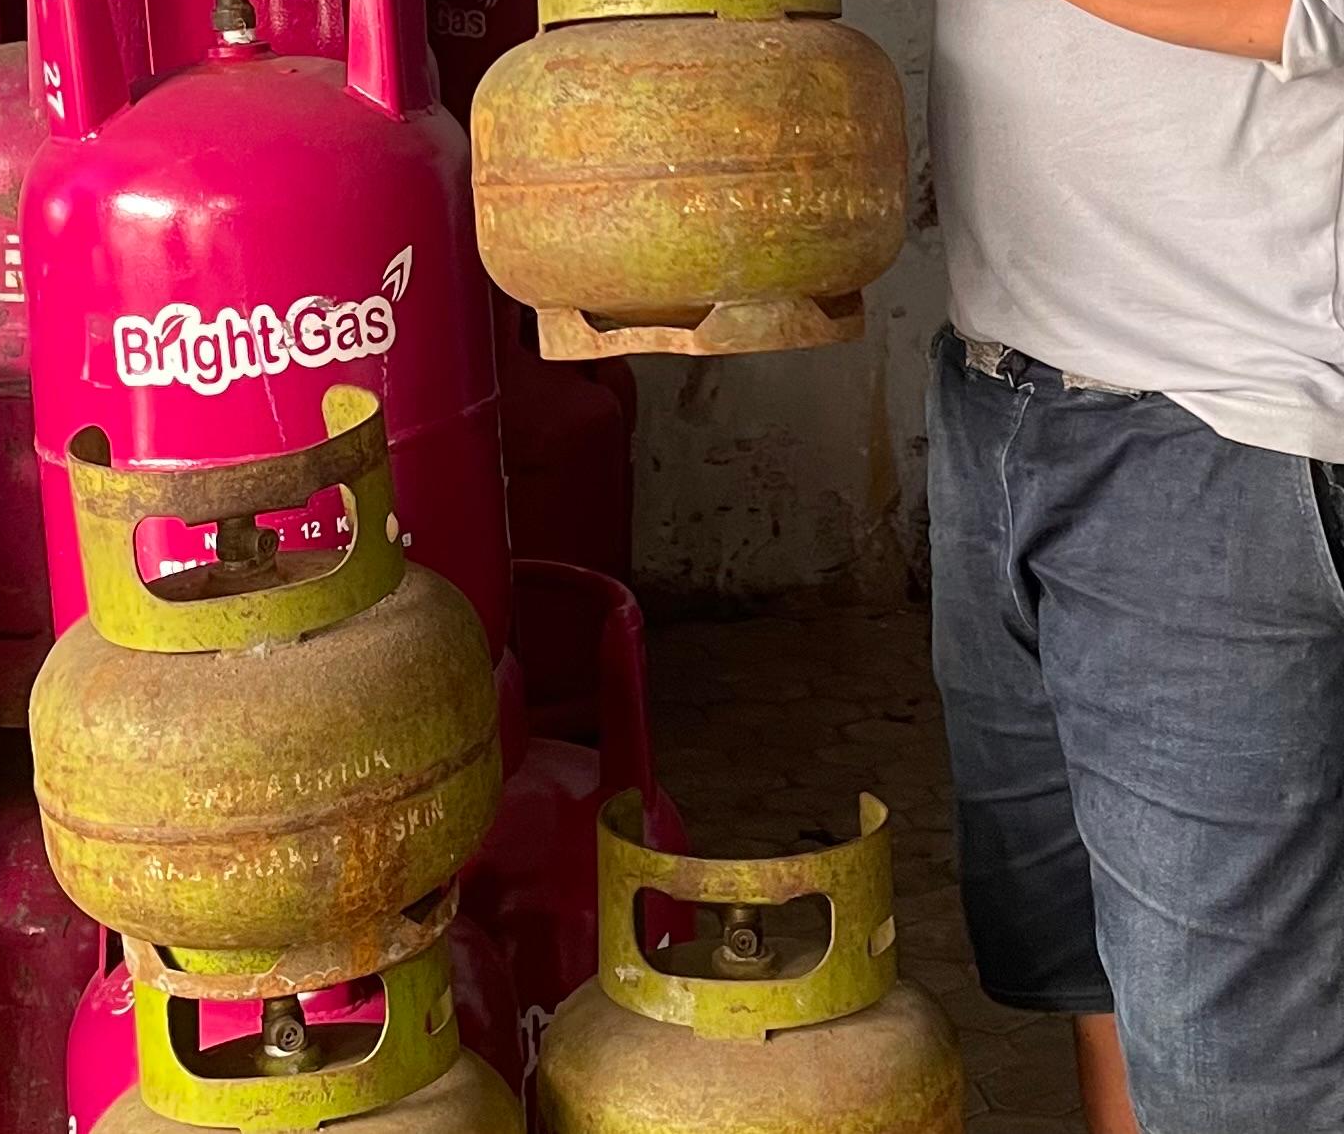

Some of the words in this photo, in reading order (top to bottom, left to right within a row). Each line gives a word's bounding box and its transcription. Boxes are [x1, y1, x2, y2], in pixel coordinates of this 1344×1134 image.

[43, 60, 66, 120] 27
[119, 311, 282, 387] Bright
[291, 304, 392, 359] Gas
[301, 520, 322, 540] 12
